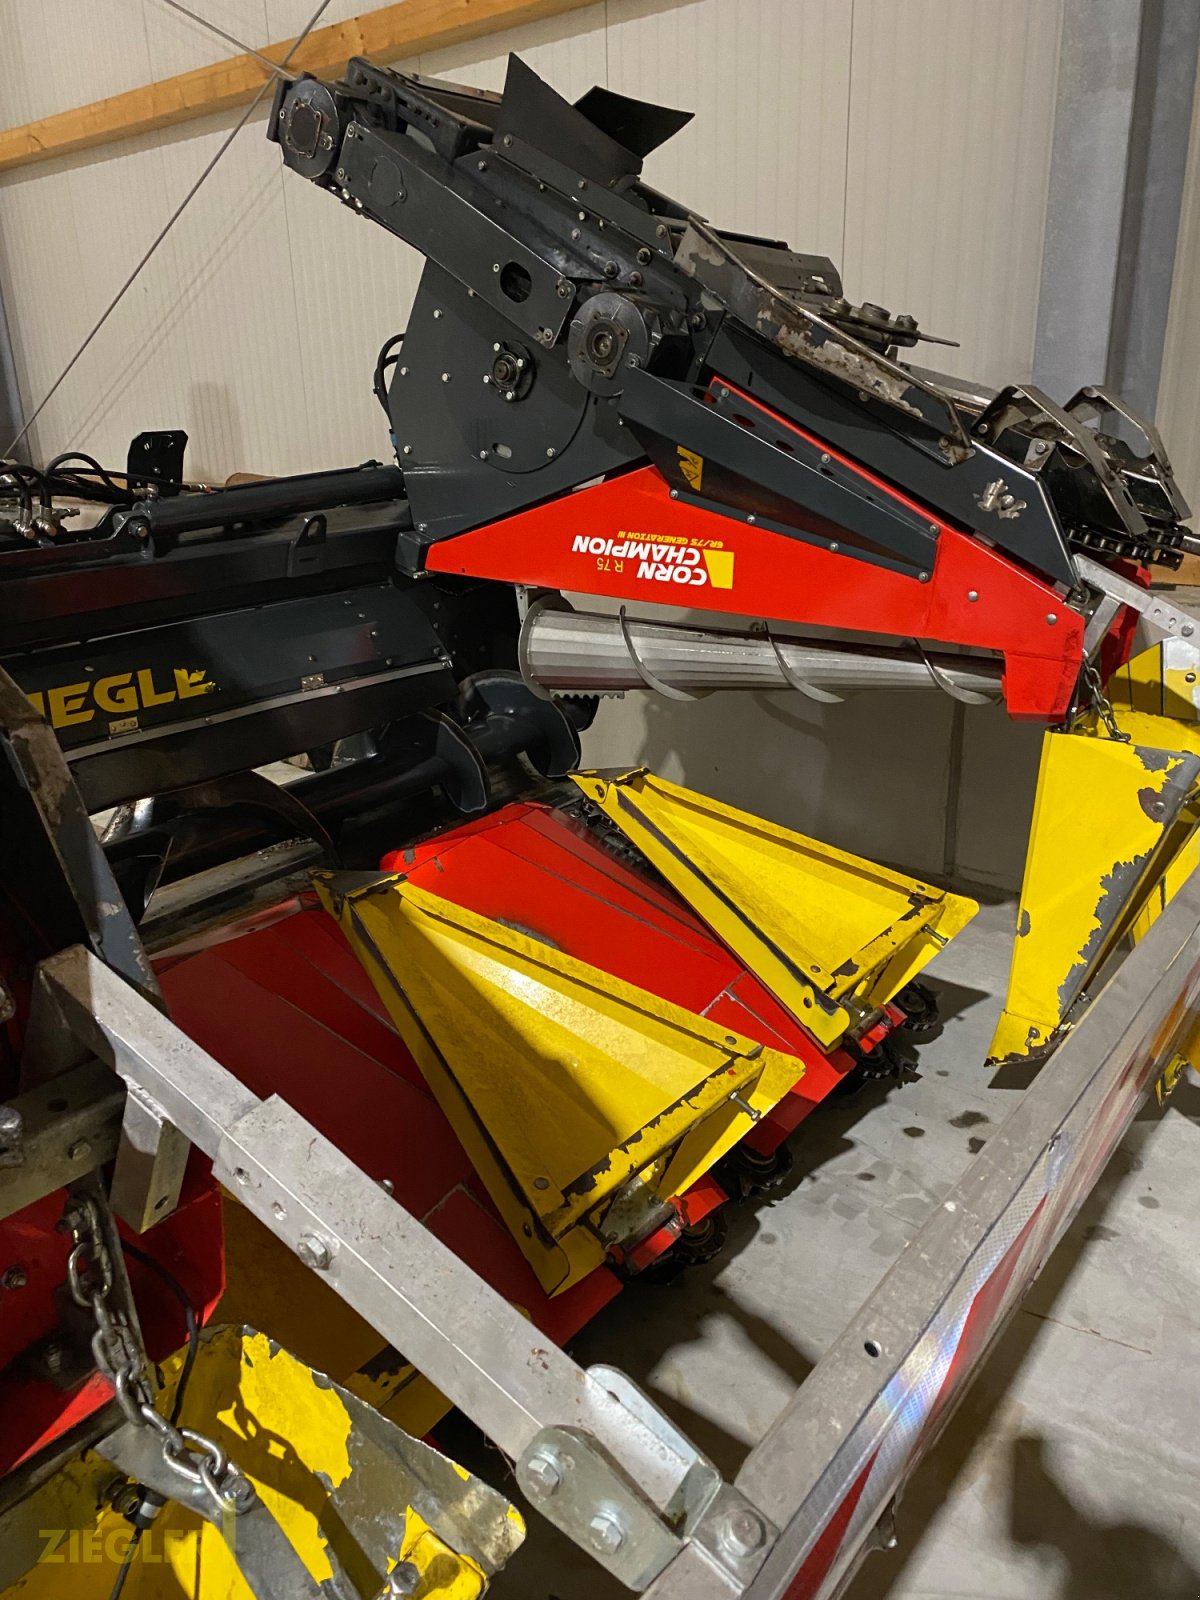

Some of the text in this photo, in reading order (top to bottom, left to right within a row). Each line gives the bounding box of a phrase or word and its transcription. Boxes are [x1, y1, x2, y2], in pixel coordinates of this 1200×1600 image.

[627, 531, 689, 545] GENERATION
[571, 535, 701, 566] CHAMPION
[596, 557, 624, 573] R 75
[636, 561, 708, 586] CORN
